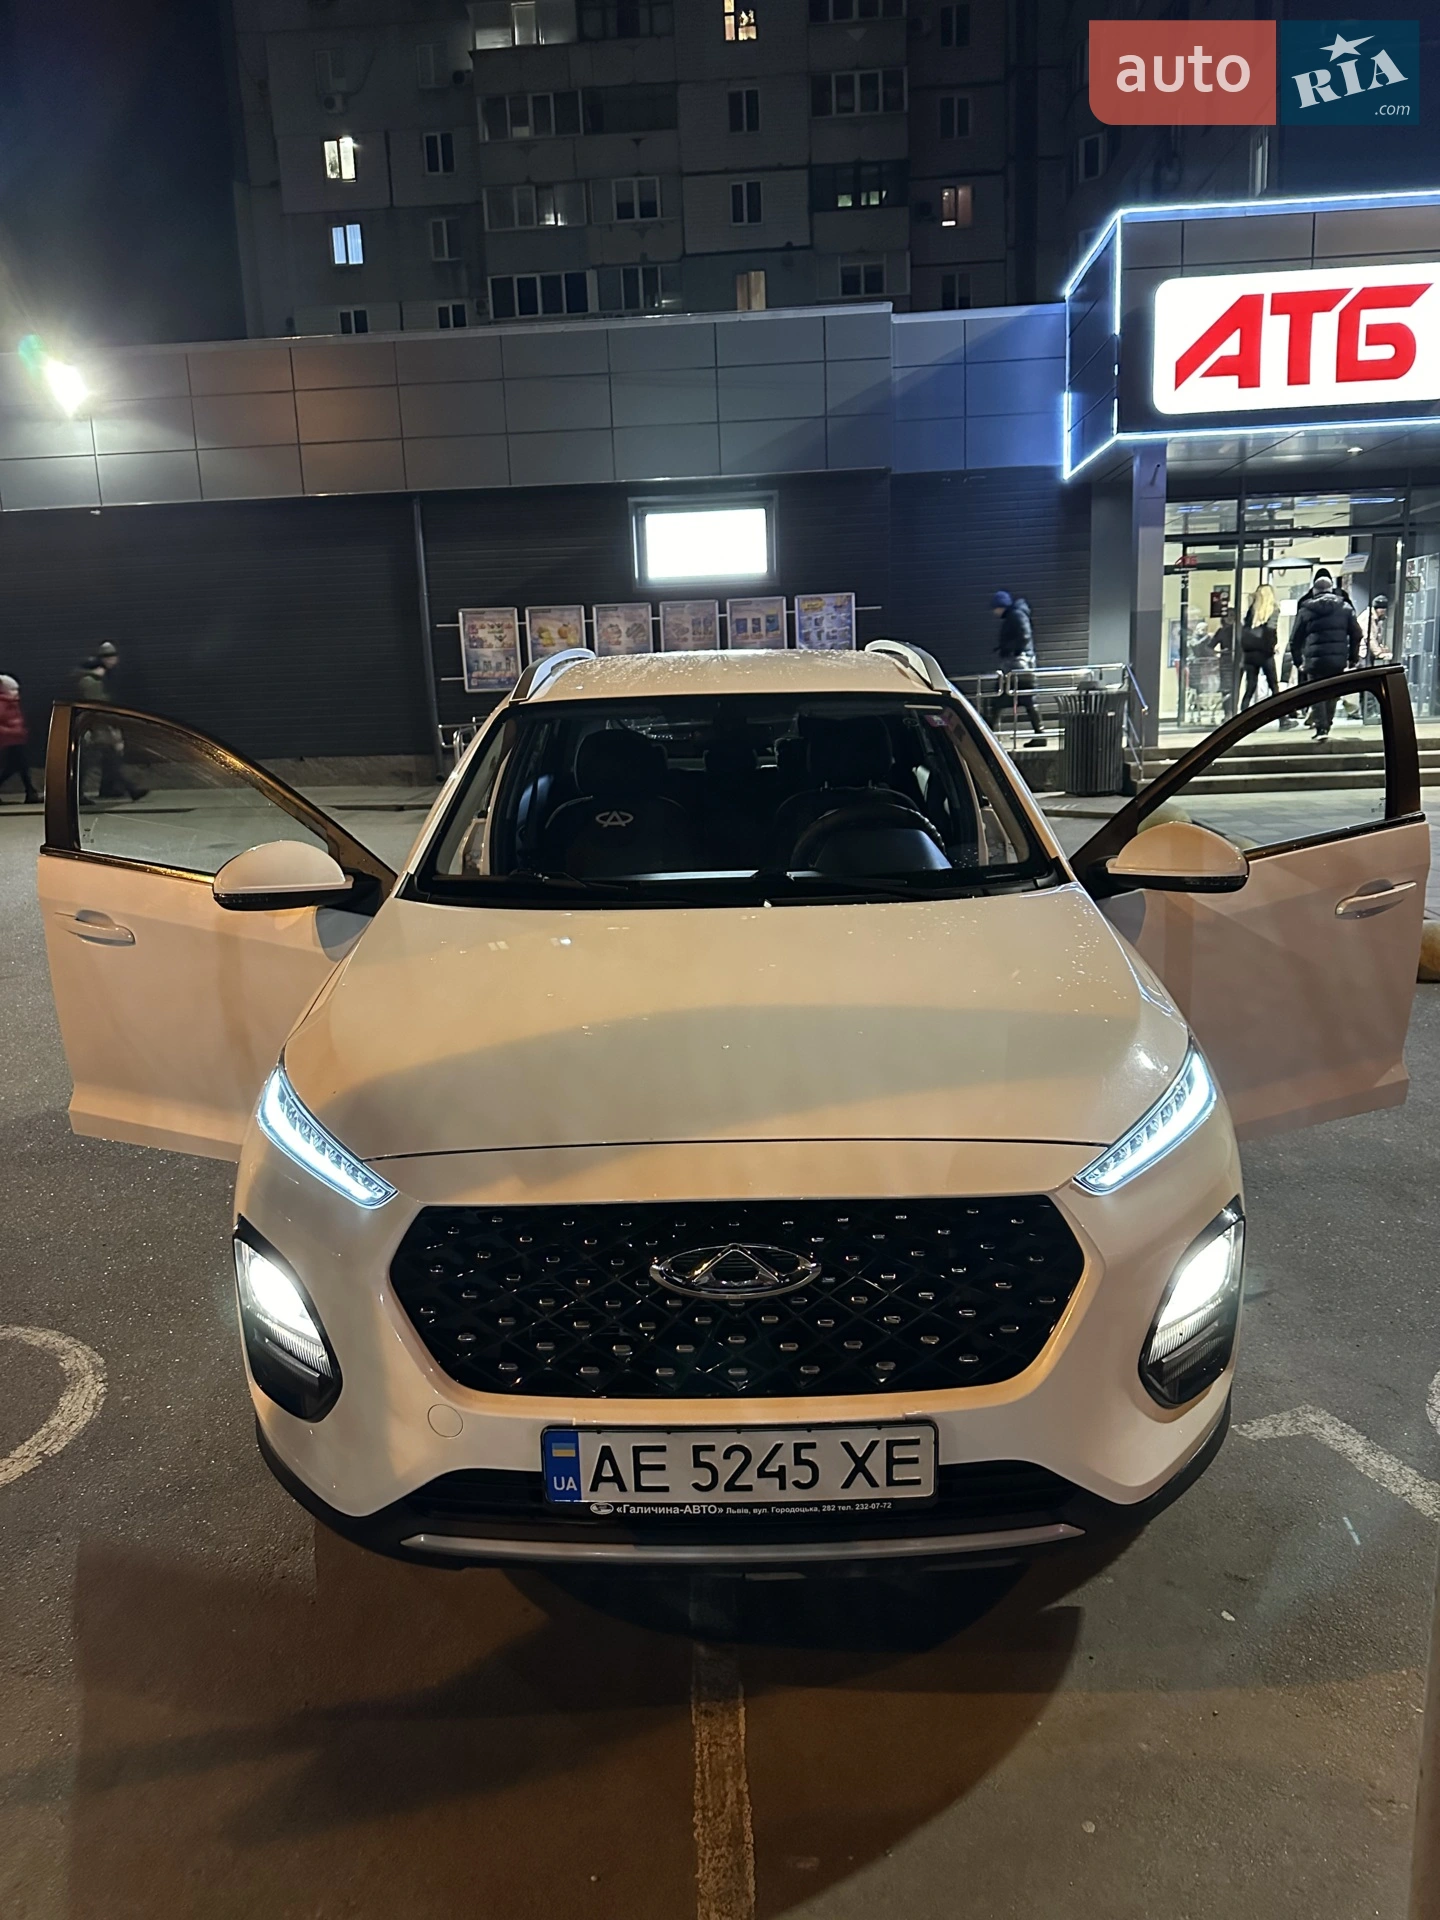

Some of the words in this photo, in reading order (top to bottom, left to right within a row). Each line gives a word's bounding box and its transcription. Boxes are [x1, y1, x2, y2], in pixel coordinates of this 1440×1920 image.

[1174, 283, 1434, 391] АТБ
[589, 1445, 670, 1493] AE
[691, 1440, 820, 1493] 5245
[840, 1438, 922, 1489] XE
[553, 1476, 578, 1491] UA
[616, 1504, 724, 1515] «Галичина-АВТО»
[752, 1508, 769, 1516] вул.
[855, 1502, 892, 1511] 232-07-72
